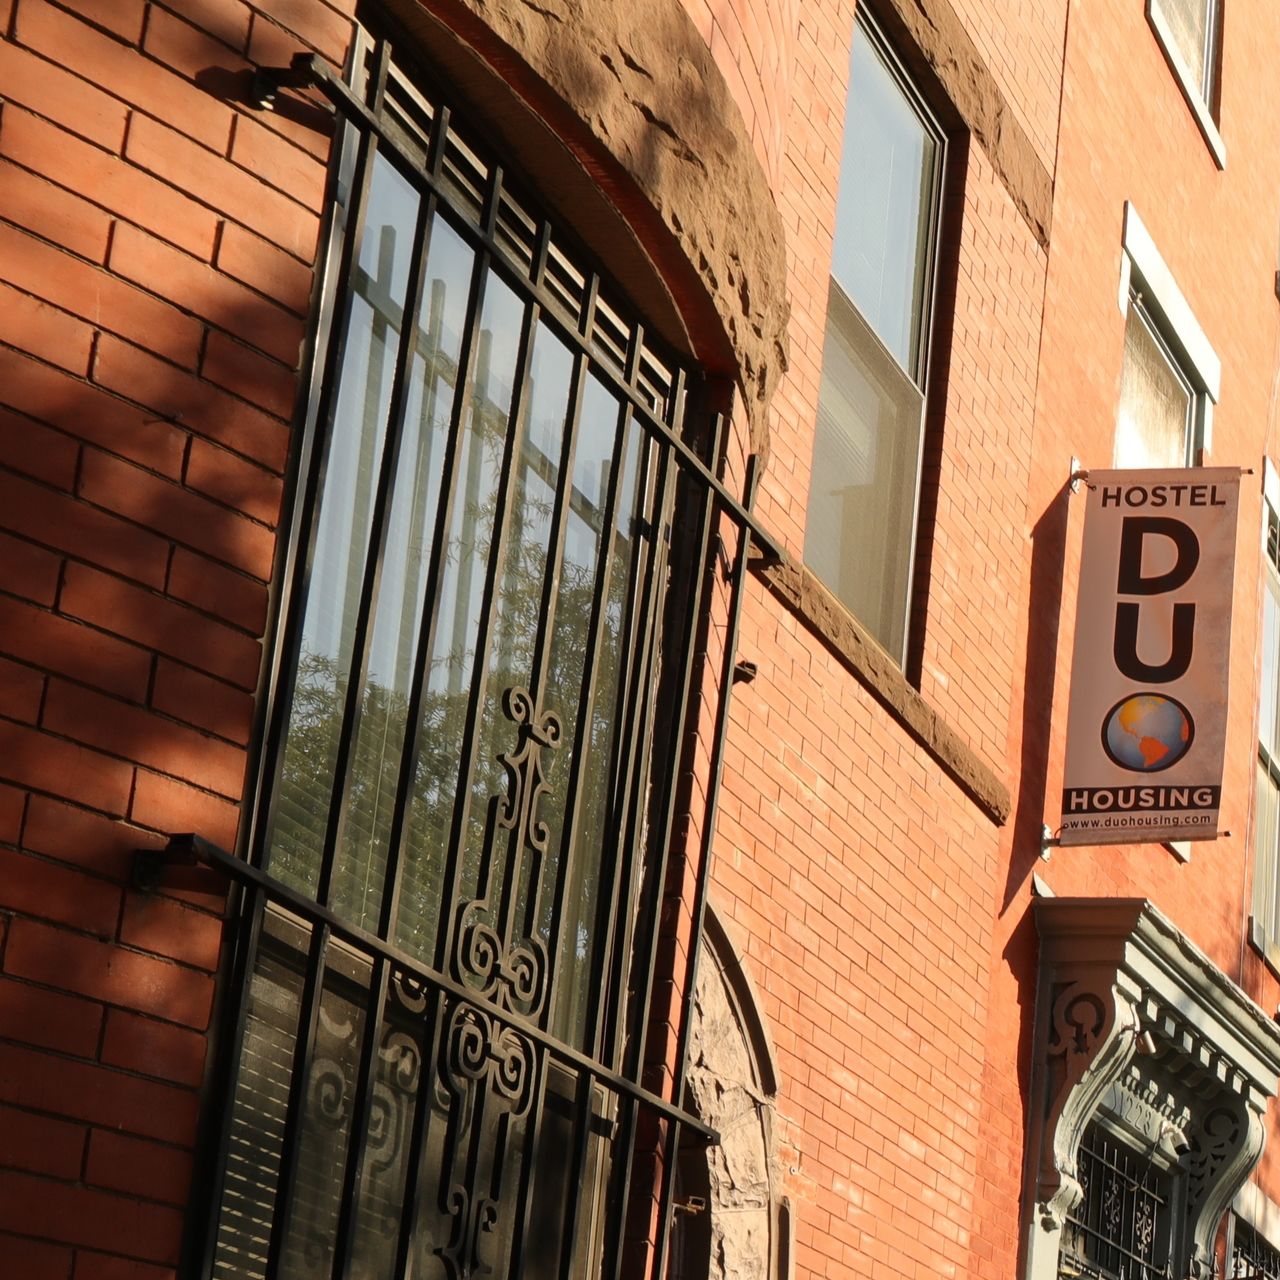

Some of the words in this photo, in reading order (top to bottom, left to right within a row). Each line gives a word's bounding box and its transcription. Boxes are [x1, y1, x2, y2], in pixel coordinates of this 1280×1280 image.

[1101, 485, 1227, 508] HOSTEL
[1070, 788, 1213, 810] HOUSING
[1070, 814, 1211, 829] www.duohousing.com
